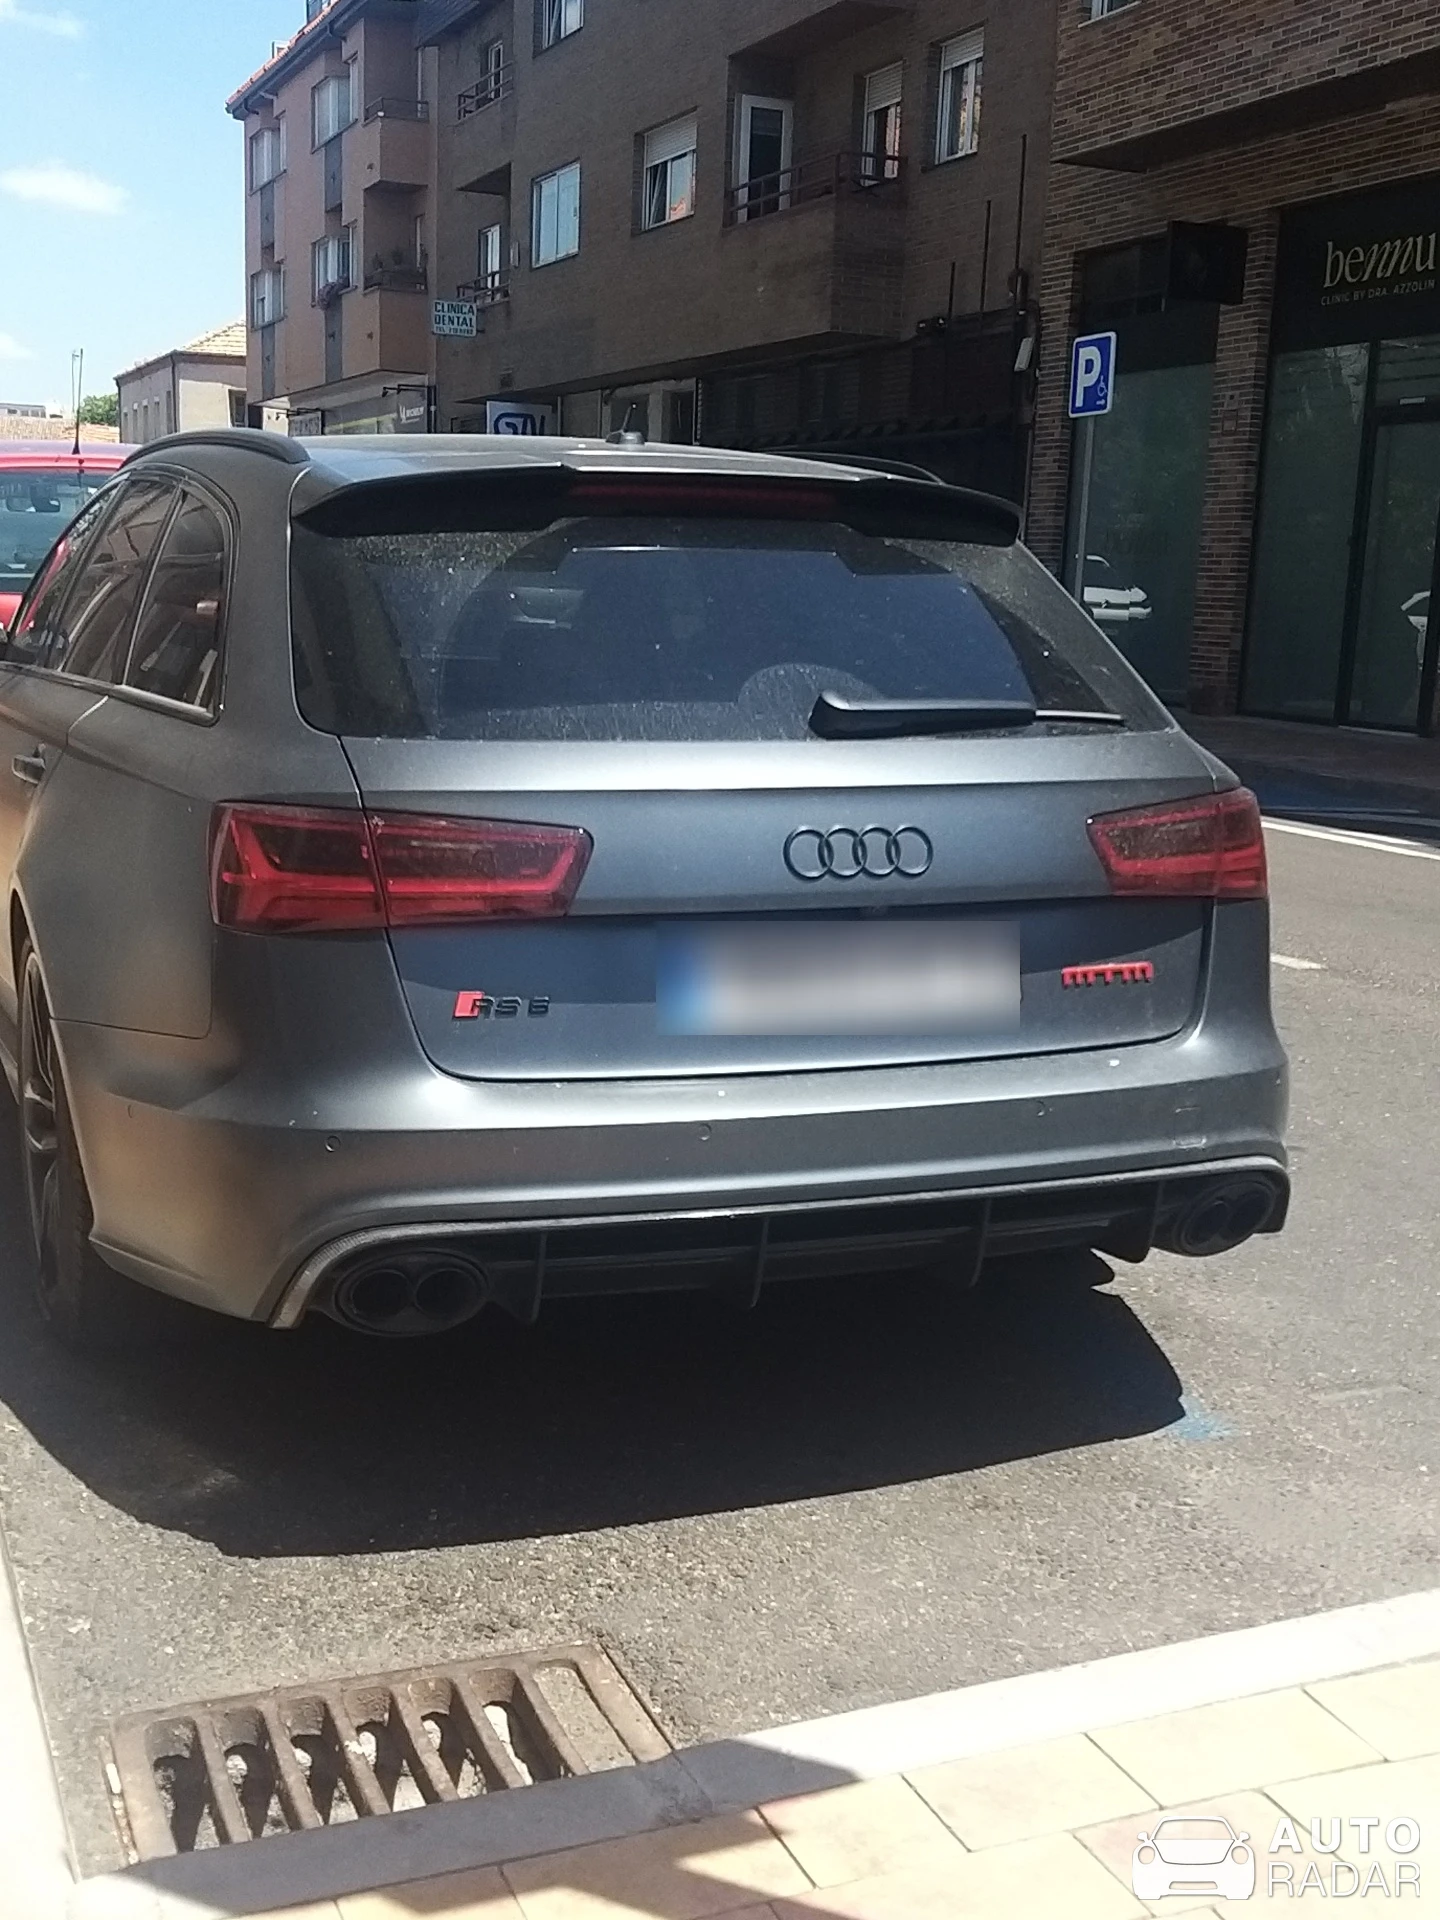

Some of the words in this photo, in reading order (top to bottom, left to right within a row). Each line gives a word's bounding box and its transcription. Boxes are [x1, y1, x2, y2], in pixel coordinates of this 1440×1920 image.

[1323, 232, 1437, 288] bennu
[1321, 292, 1350, 306] CLINIC
[1353, 290, 1366, 301] BY
[434, 314, 474, 328] DENTAL
[1075, 346, 1102, 408] P
